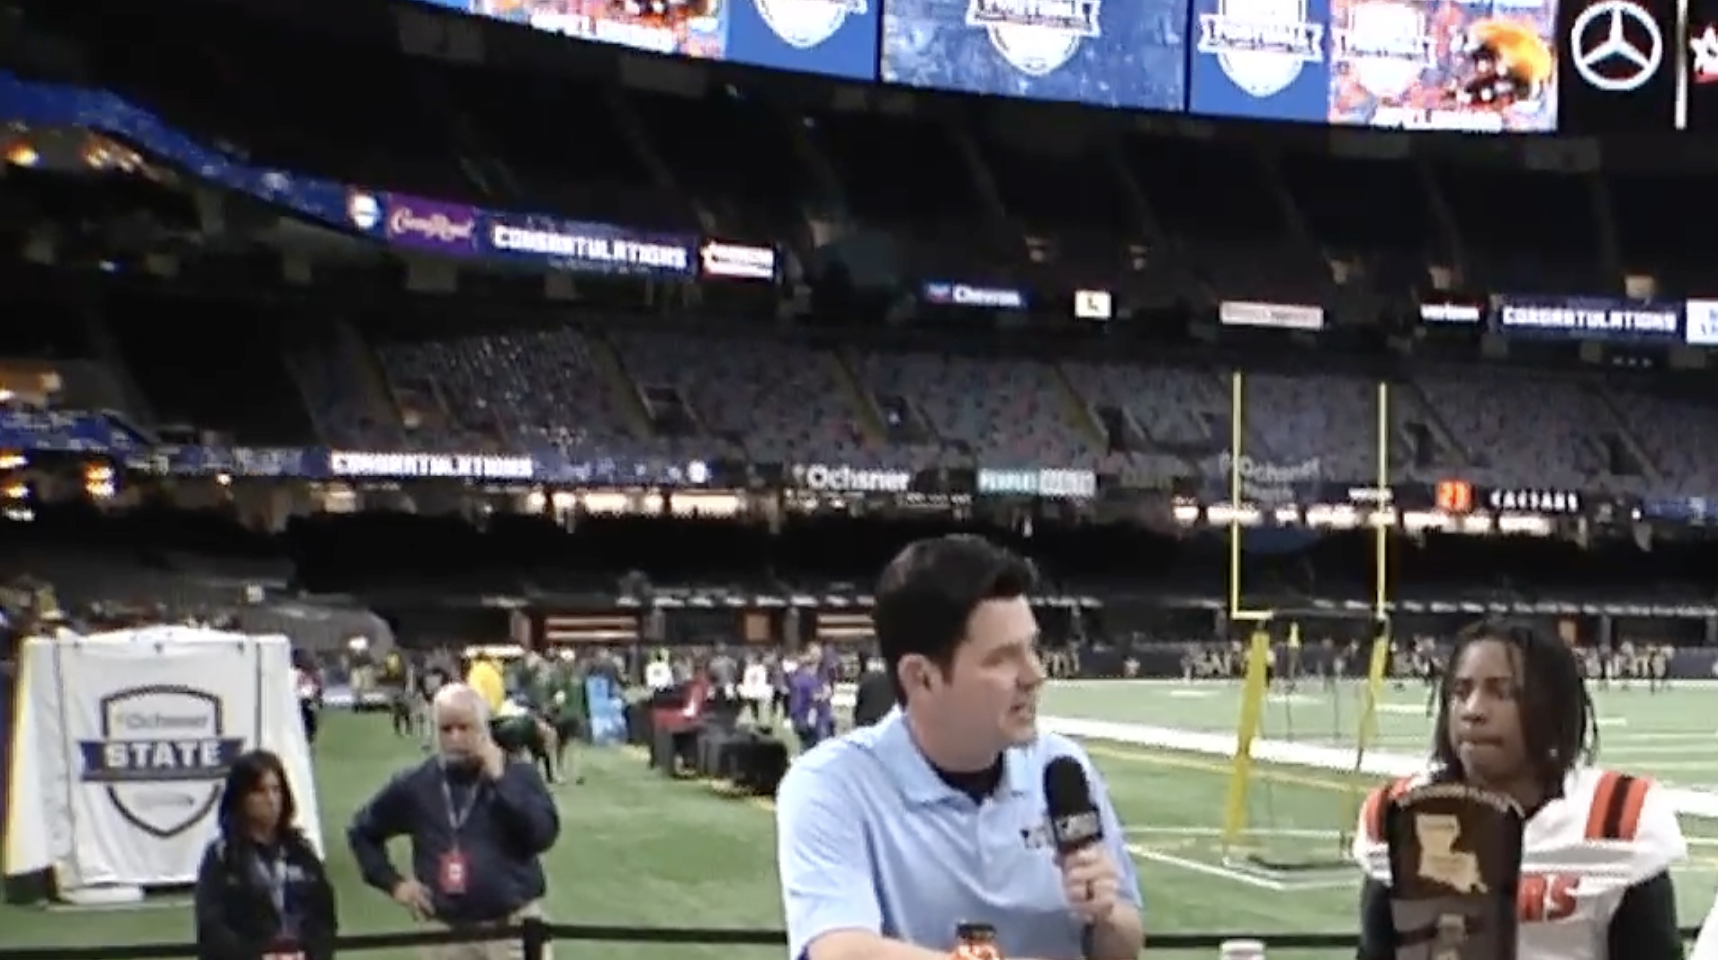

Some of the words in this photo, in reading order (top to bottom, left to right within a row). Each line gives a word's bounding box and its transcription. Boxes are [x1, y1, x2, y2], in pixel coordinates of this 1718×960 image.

[1502, 306, 1678, 332] CONGRATULATIONS
[806, 463, 910, 492] Ochsner
[105, 740, 219, 769] STATE
